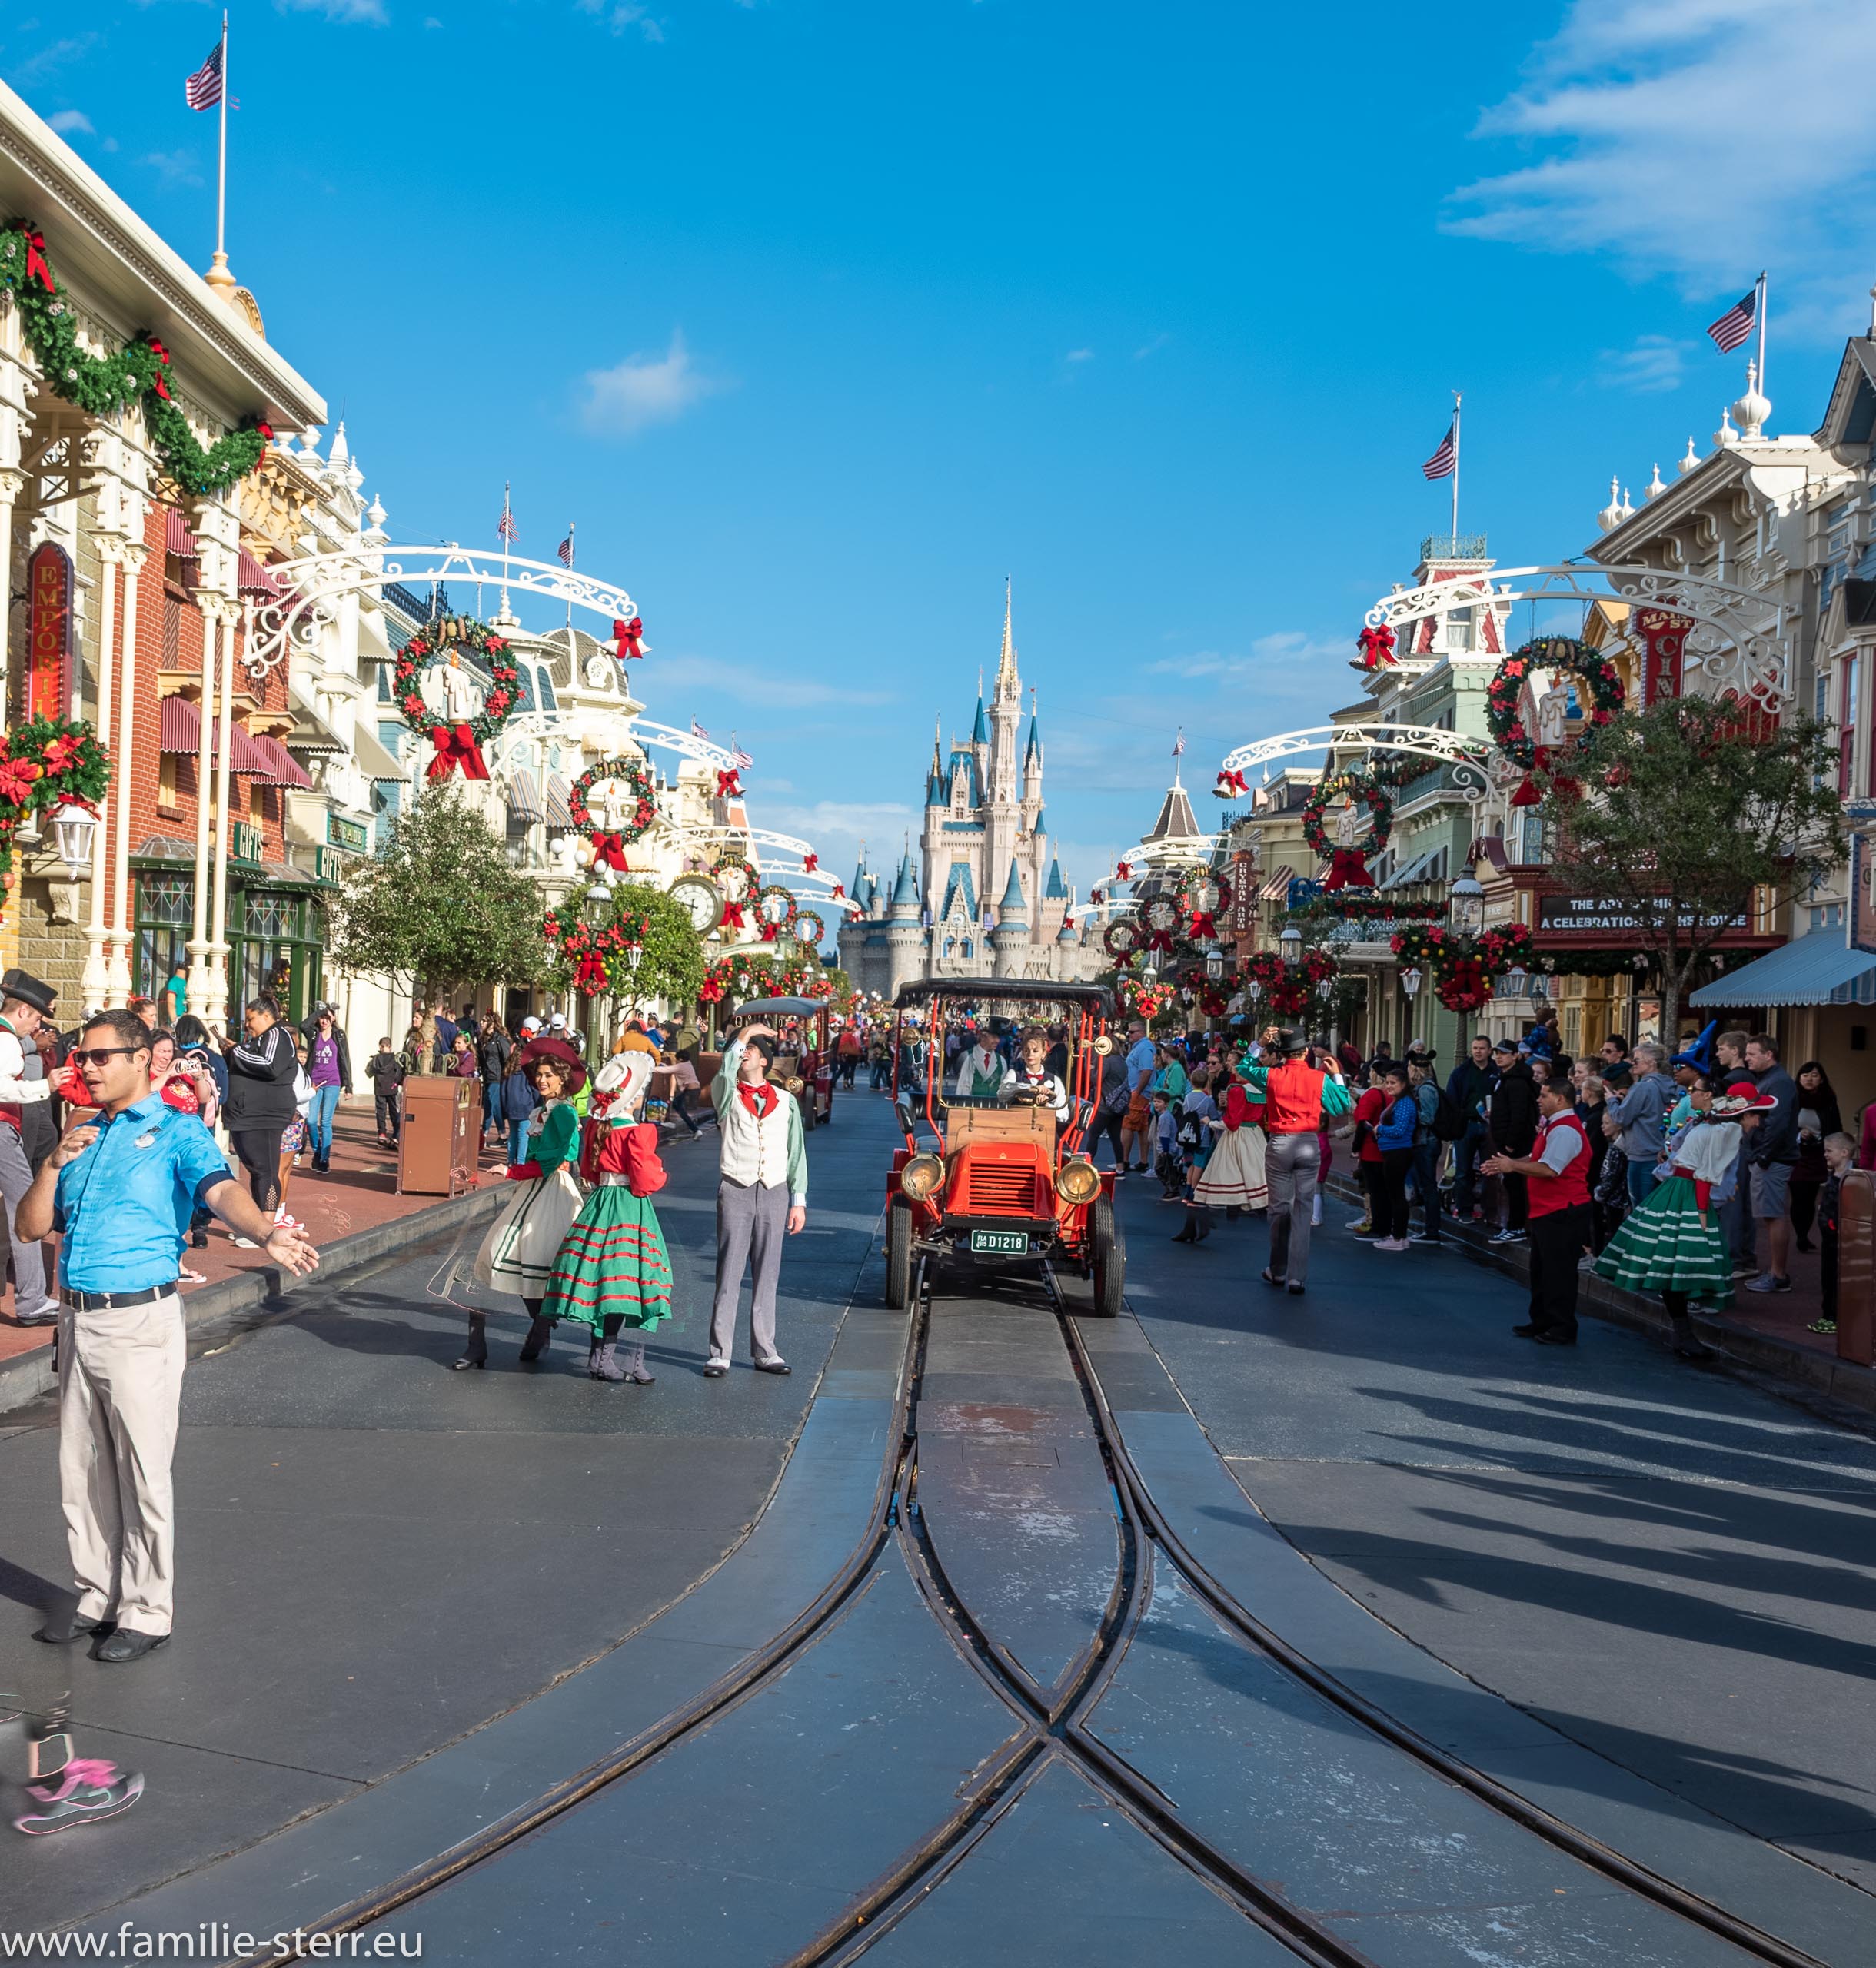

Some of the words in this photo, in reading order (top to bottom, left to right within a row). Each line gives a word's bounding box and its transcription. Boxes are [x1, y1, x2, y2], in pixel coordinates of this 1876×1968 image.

[35, 566, 60, 716] EMPORIU
[1654, 635, 1678, 707] CIN
[240, 824, 263, 862] GIFTS
[321, 847, 343, 883] GIFTS
[1238, 862, 1247, 901] CRYSTAL
[1237, 906, 1246, 929] ARTS
[1570, 899, 1594, 910] THE
[1541, 918, 1551, 929] A
[989, 1236, 1022, 1248] D1218
